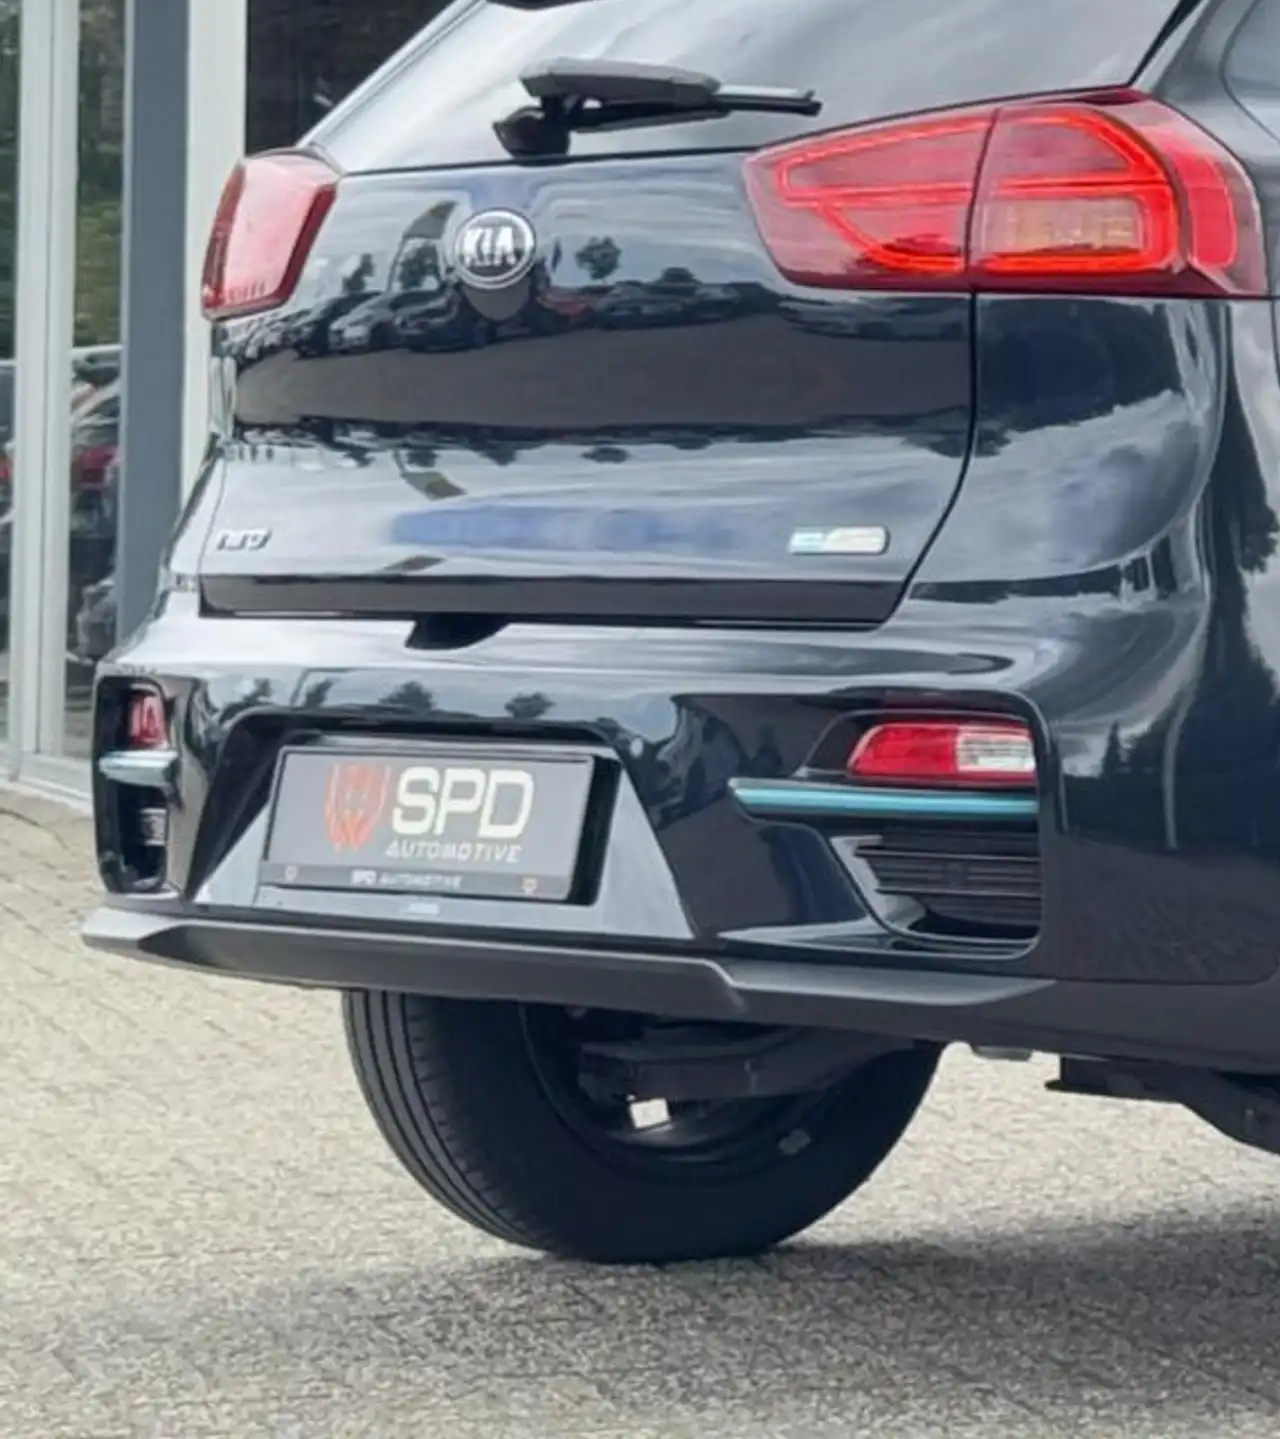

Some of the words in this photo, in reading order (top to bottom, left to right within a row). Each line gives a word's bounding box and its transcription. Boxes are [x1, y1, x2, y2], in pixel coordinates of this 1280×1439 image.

[464, 227, 516, 267] KIA
[392, 766, 534, 839] SPD
[385, 840, 523, 863] AUTOMOTIVE
